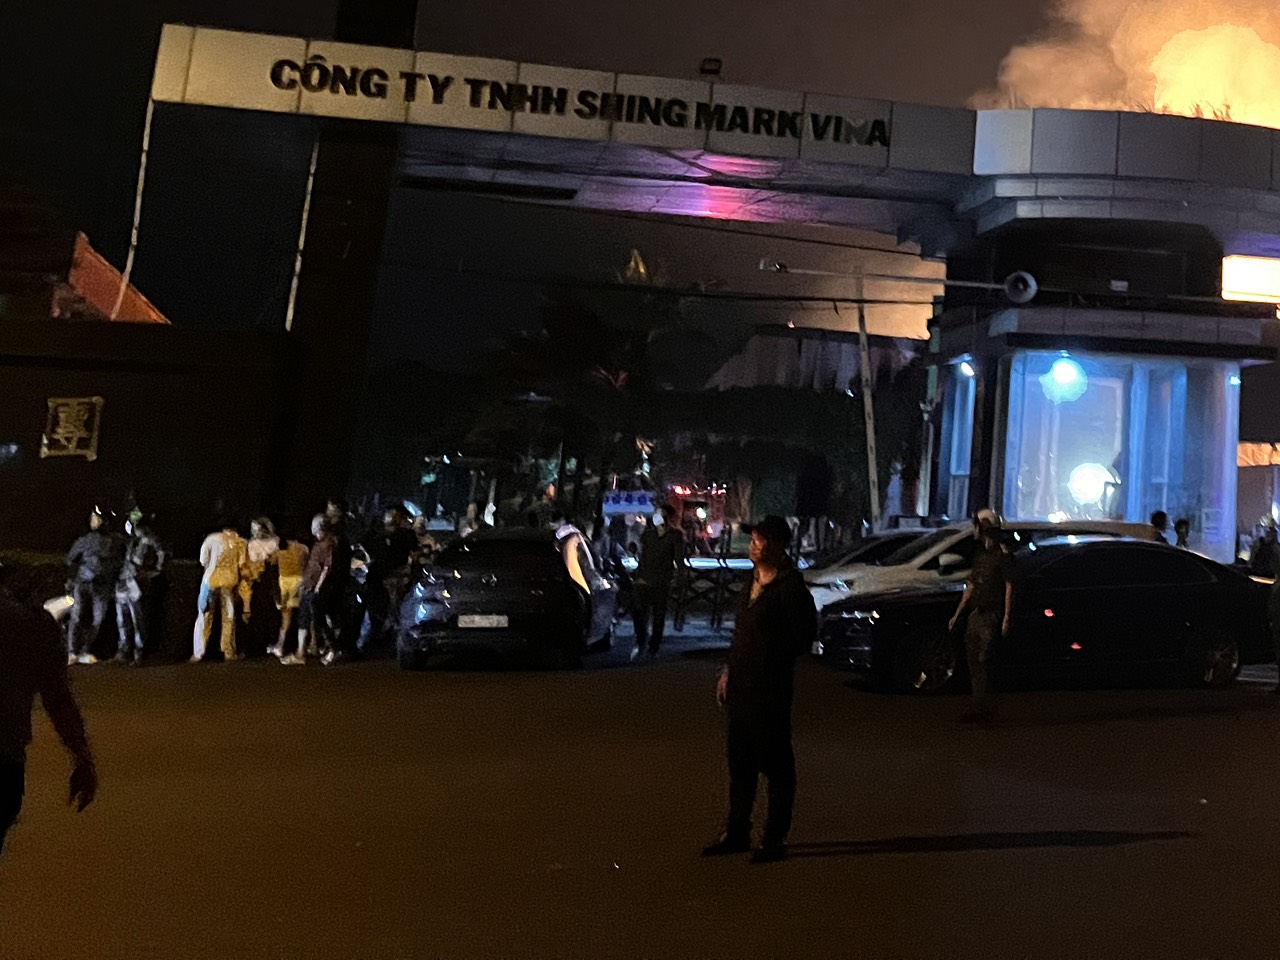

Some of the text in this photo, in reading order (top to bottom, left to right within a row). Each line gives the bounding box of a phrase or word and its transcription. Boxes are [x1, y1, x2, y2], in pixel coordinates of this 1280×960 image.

[270, 54, 389, 99] CÔNG
[400, 71, 454, 105] TY
[464, 77, 568, 115] TNHH
[574, 90, 688, 128] SHING
[694, 102, 802, 139] MARK
